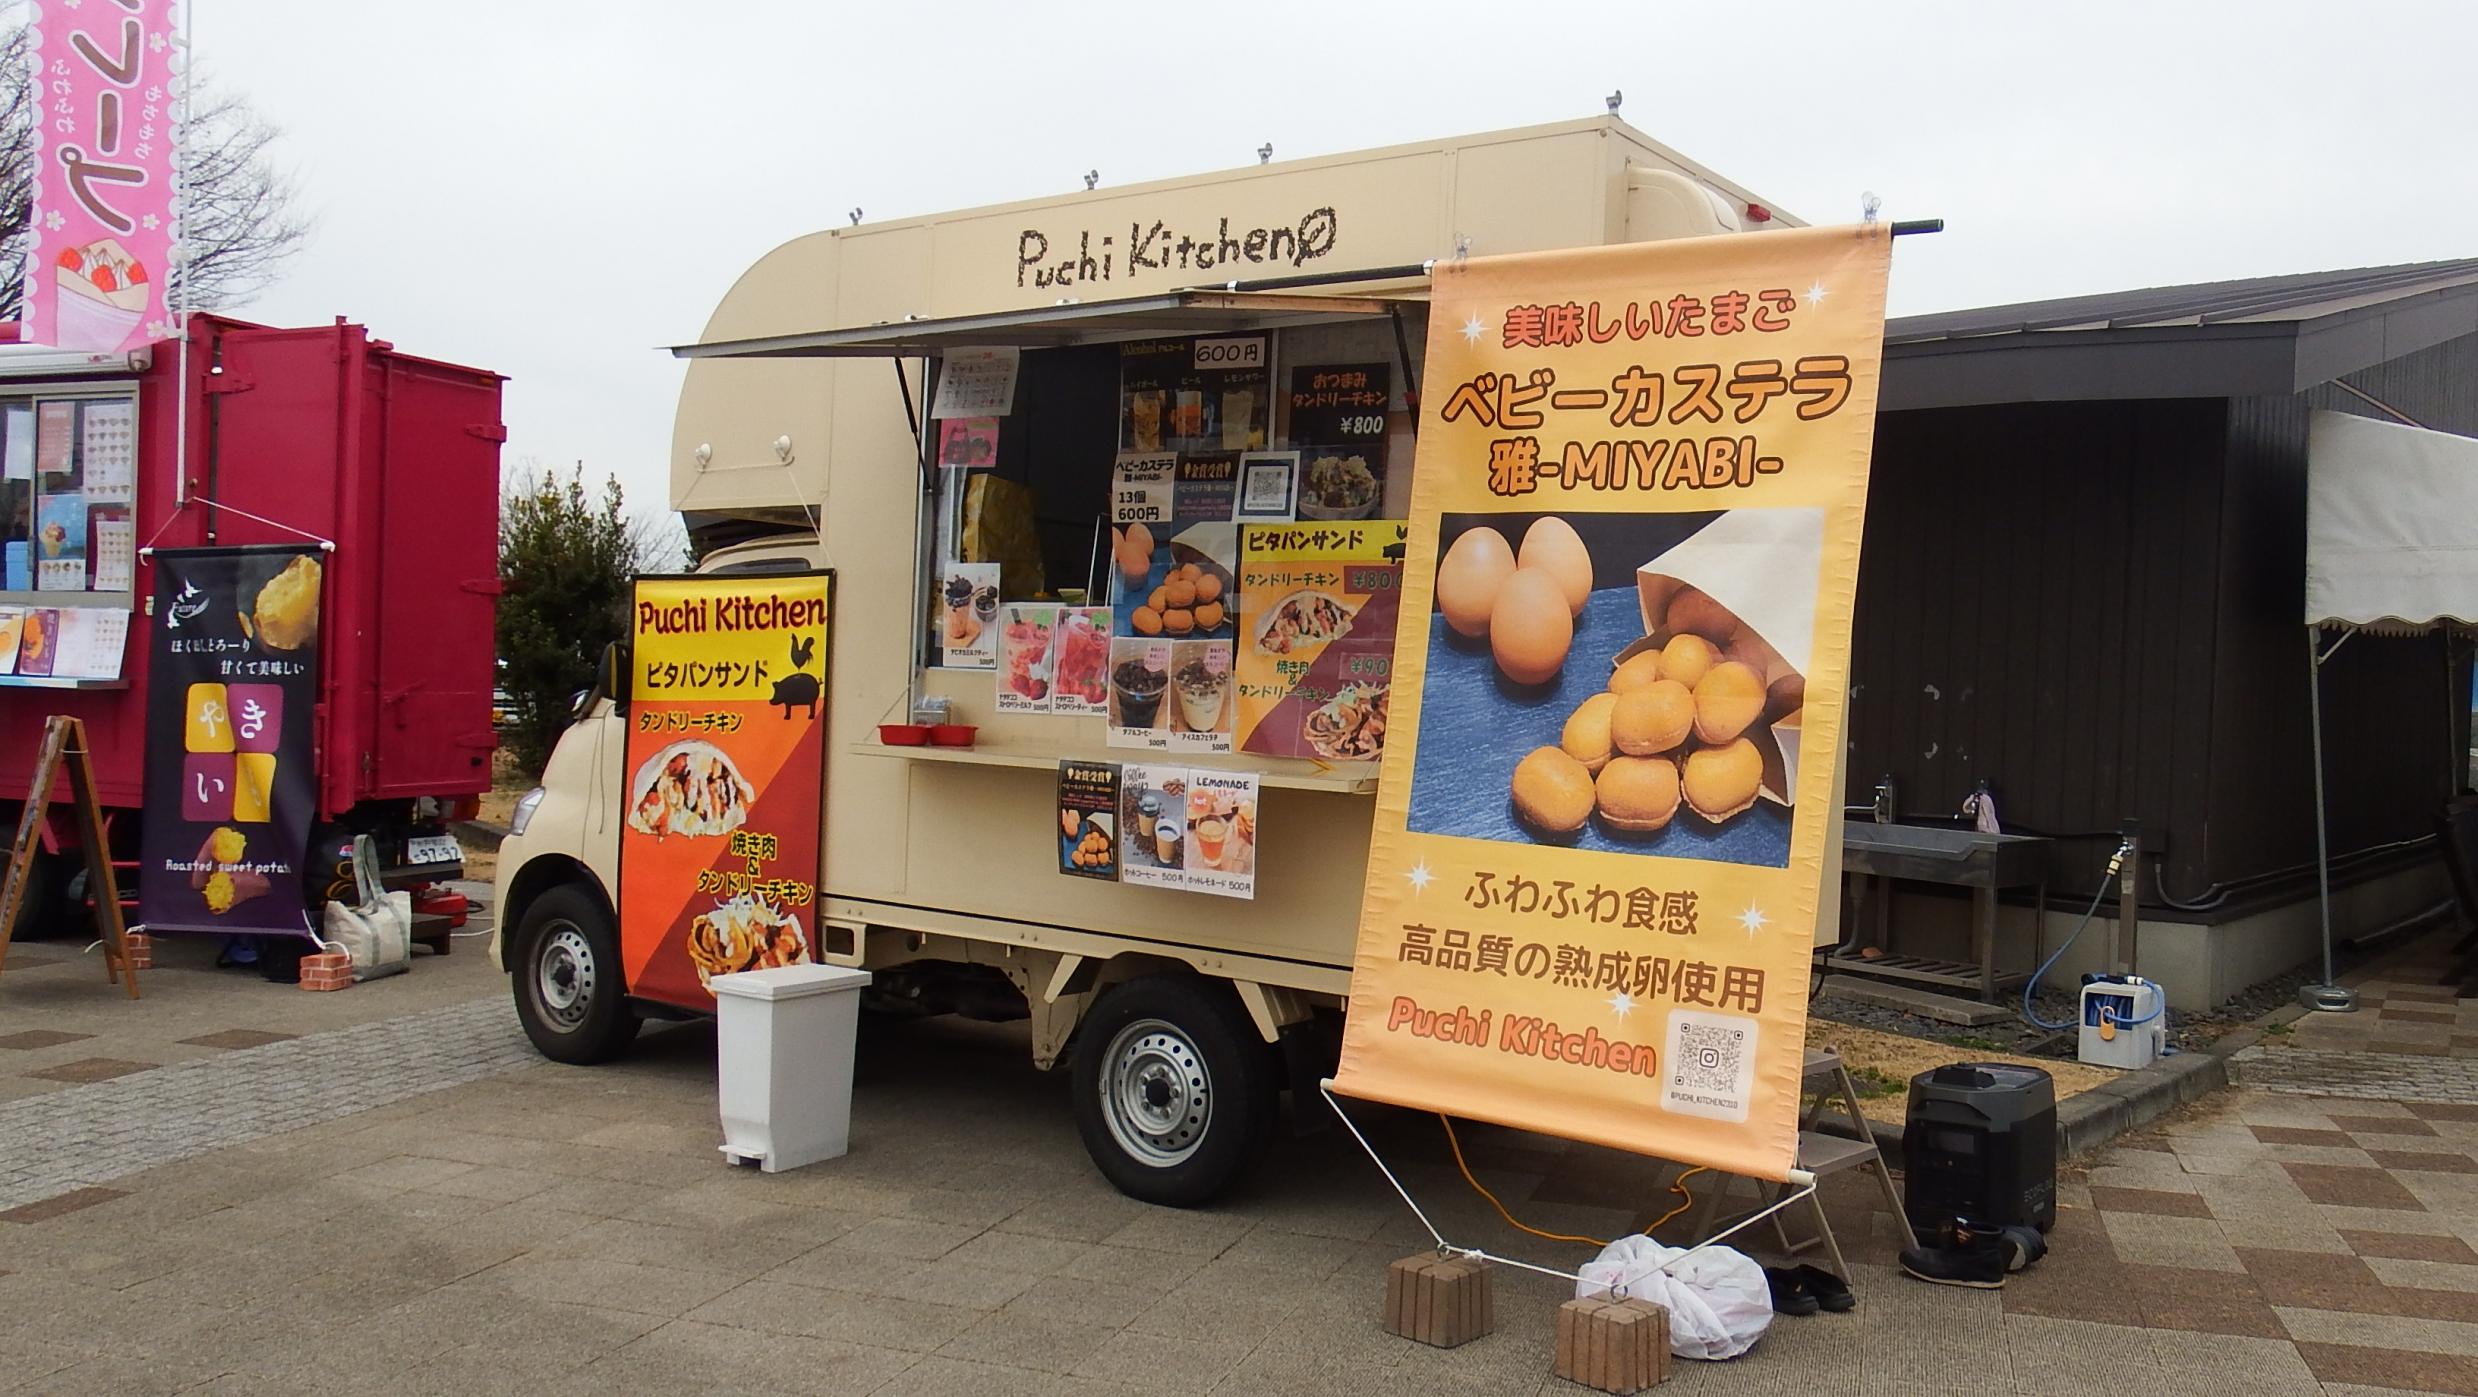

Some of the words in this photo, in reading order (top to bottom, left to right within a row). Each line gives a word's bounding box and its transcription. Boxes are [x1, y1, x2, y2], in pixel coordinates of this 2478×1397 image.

[1017, 229, 1112, 289] Puchi
[1503, 289, 1796, 349] 美味しいたまご
[1196, 344, 1258, 361] 600円
[1313, 372, 1367, 389] おつまみ
[1293, 391, 1387, 409] タンドリーチキン
[1442, 355, 1852, 431] ベビーカステラ
[1340, 416, 1384, 435] ¥800
[1489, 435, 1784, 497] 雅-MIYABI-
[1118, 490, 1146, 504] 13個
[1118, 506, 1160, 520] 600円
[1248, 530, 1364, 552] ピタパンサンド
[1245, 572, 1340, 586] タンドリーチキン
[638, 597, 707, 635] Puchi
[715, 595, 826, 632] Kitchen
[220, 658, 304, 677] 甘くて美味しい
[647, 660, 768, 689] ピタパンサンド
[1238, 684, 1330, 701] タンドリーチキン
[639, 712, 743, 733] タンドリーチキン
[1197, 777, 1249, 790] LEMONADE
[730, 832, 776, 860] 焼き肉
[165, 859, 212, 872] Roasted
[218, 861, 252, 872] sweet
[747, 855, 759, 877] &
[697, 871, 813, 905] タンドリーチキン
[1465, 871, 1699, 935] ふわふわ食感
[1398, 923, 1766, 1014] 高品質の熟成卵使用
[1388, 997, 1492, 1047] Puchi
[1500, 1014, 1657, 1078] Kitchen
